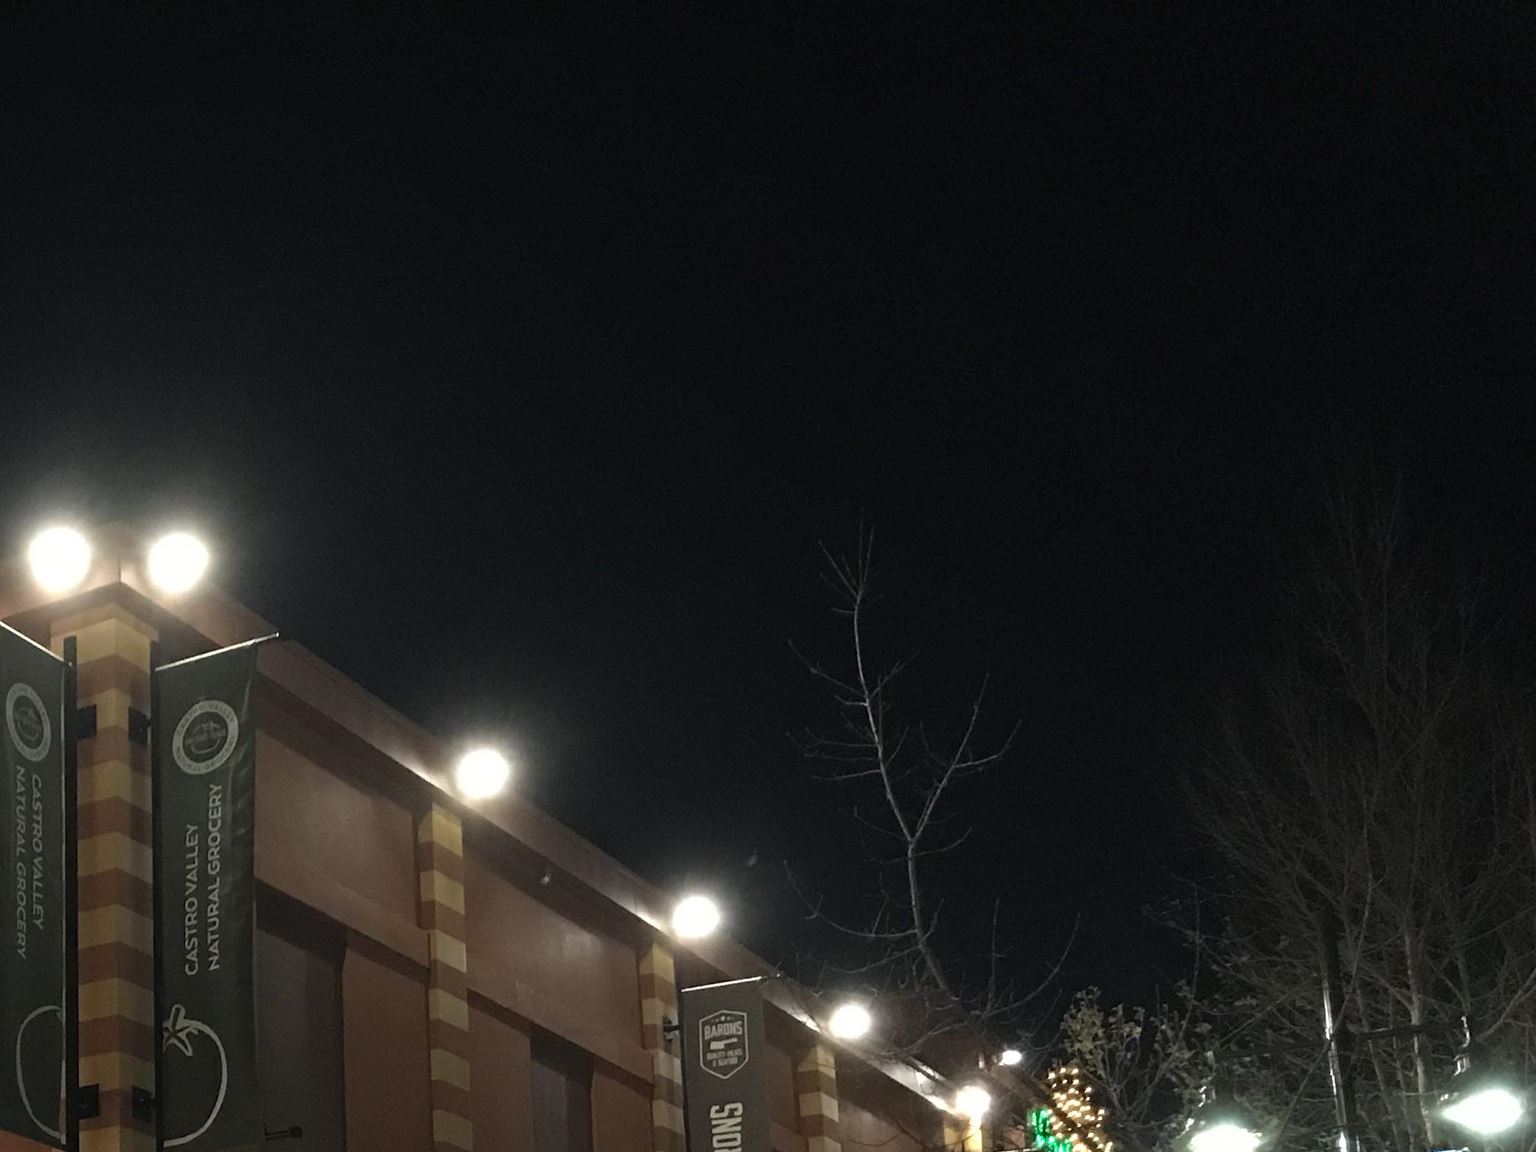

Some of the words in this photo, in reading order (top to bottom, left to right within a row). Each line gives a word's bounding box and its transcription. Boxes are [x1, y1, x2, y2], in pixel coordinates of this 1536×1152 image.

[15, 765, 27, 857] NATURAL
[32, 774, 43, 852] CASTRO
[207, 783, 223, 875] GROCERY
[32, 856, 44, 930] VALLEY
[184, 823, 199, 896] VALLEY
[16, 861, 28, 961] GROCERY
[184, 897, 199, 976] CASTRO
[207, 876, 221, 971] NATURAL
[704, 1020, 742, 1040] BARONS
